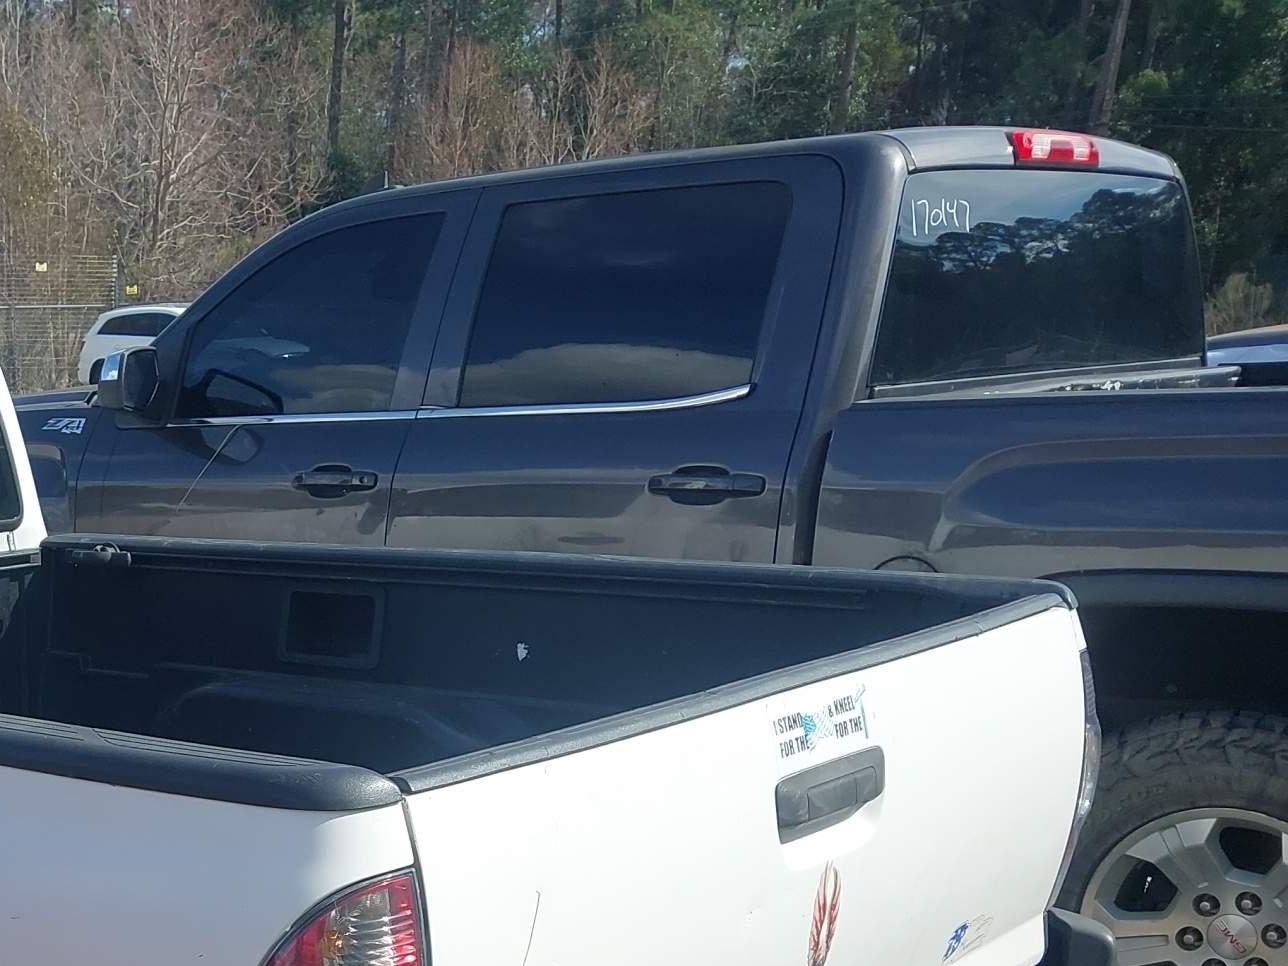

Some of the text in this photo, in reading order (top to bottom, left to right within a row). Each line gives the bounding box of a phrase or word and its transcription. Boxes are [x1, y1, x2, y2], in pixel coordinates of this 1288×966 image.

[827, 695, 856, 718] & KNEEL
[777, 712, 804, 735] STAND
[834, 715, 863, 740] FOR THE
[779, 734, 810, 759] FOR THE
